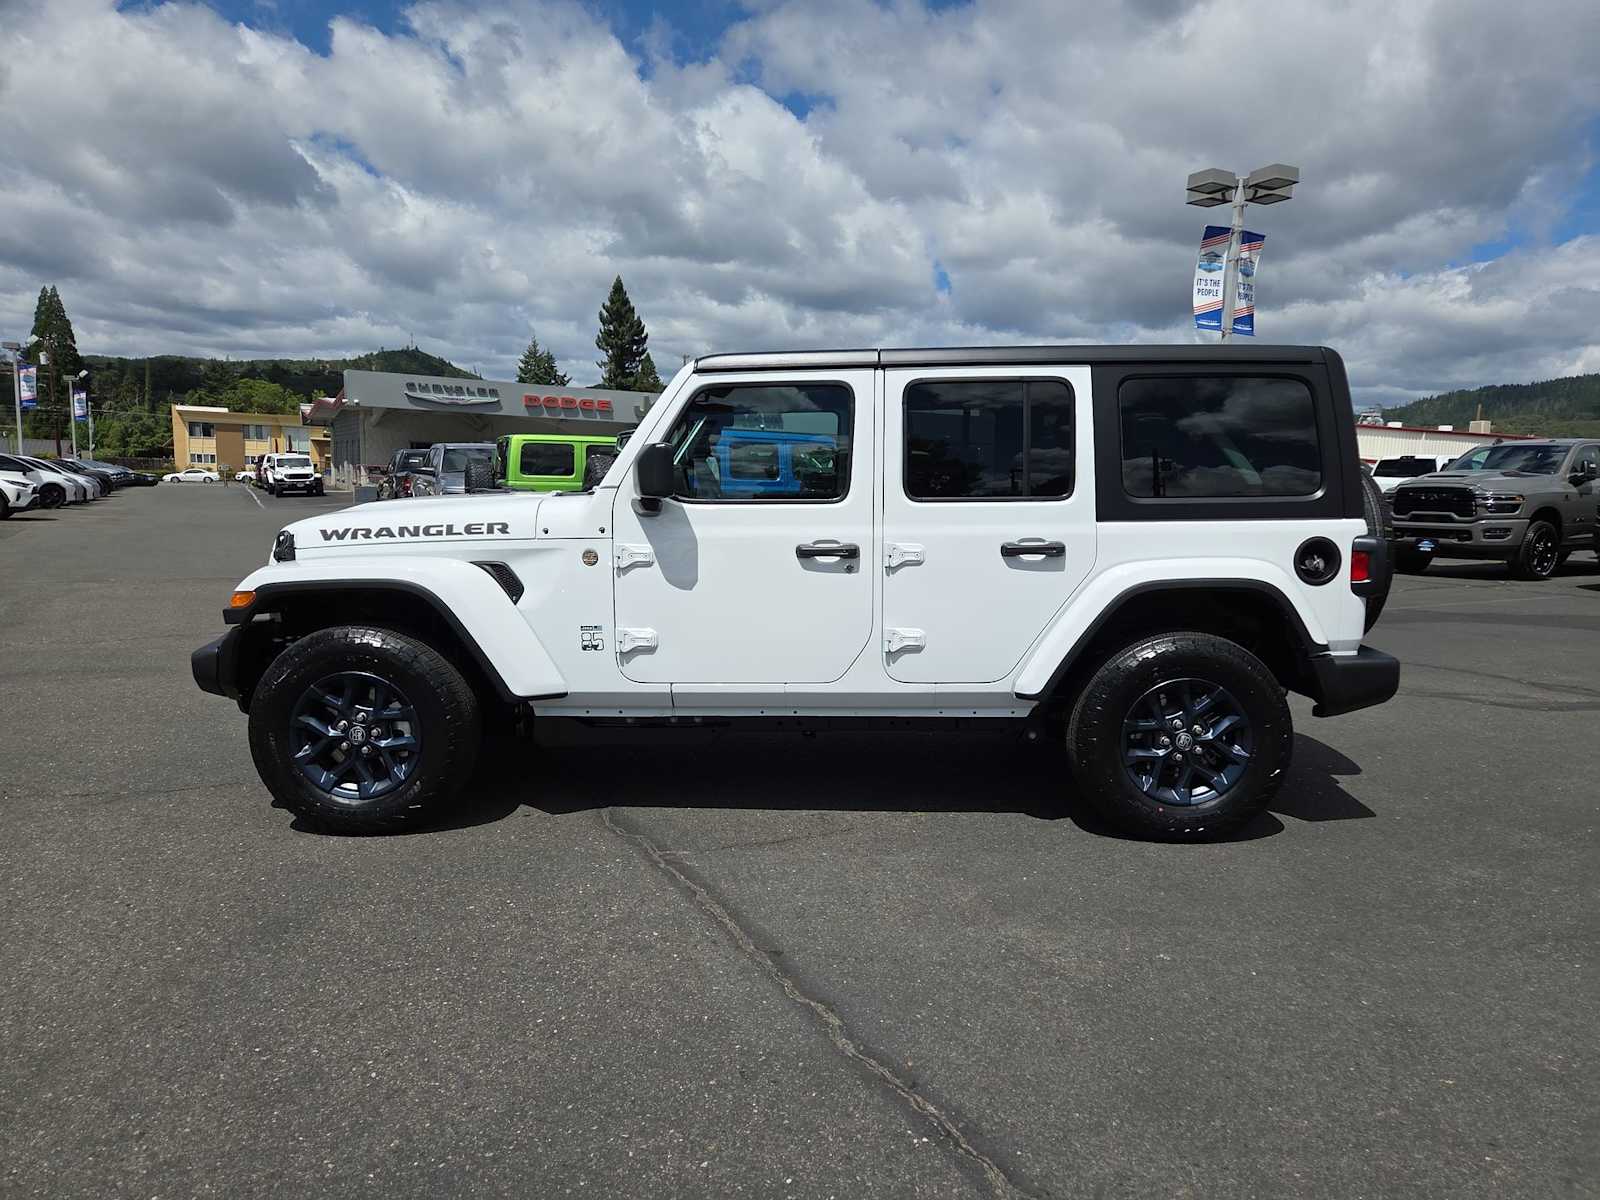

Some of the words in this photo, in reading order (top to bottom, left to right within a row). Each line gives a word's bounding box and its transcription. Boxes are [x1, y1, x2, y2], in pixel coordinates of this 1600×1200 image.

[1196, 279, 1209, 287] IT'S
[1210, 280, 1221, 288] THE
[1197, 288, 1219, 297] PEOPLE
[523, 394, 613, 412] DODGE
[319, 522, 510, 541] WRANGLER
